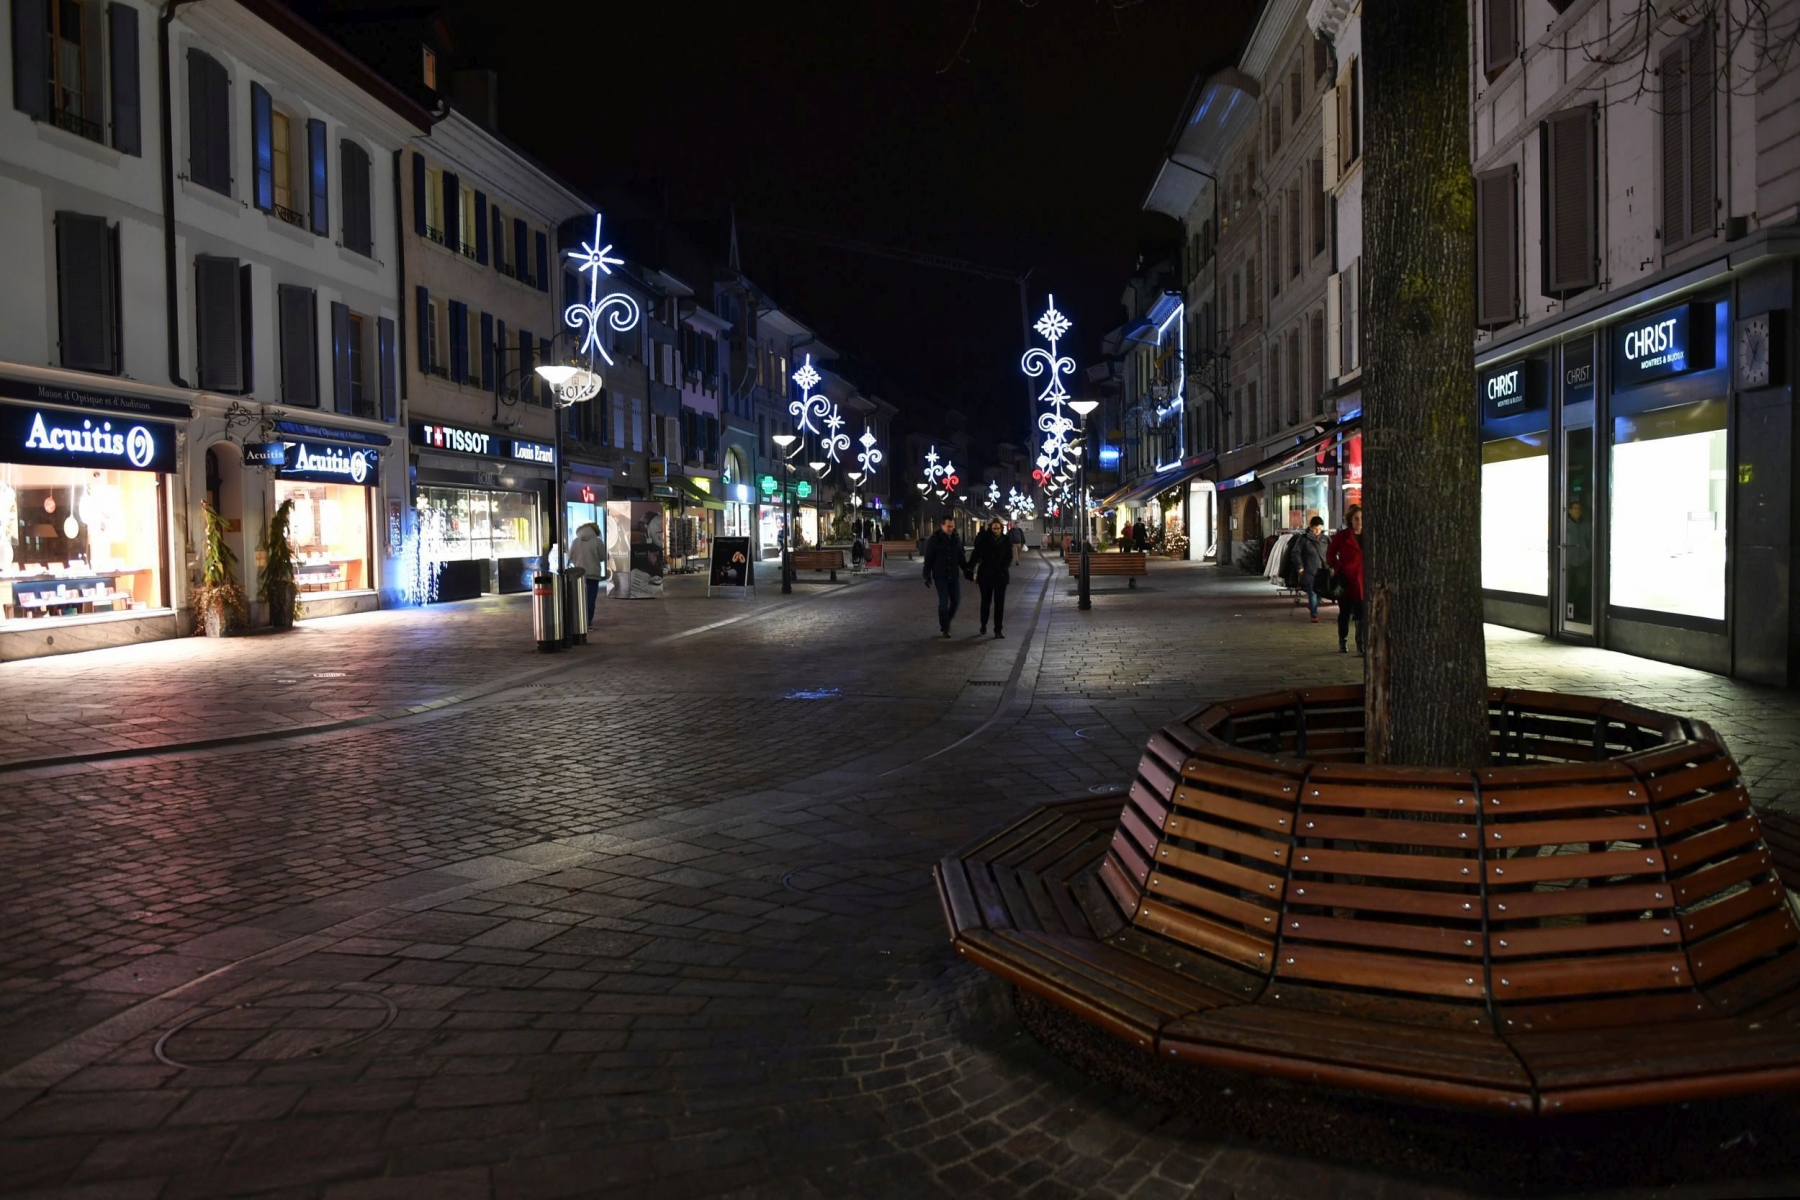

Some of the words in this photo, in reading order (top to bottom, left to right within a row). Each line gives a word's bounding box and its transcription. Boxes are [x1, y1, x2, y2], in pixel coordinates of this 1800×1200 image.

[1625, 318, 1677, 360] CHRIST
[1641, 355, 1662, 370] MONTRES
[1662, 355, 1667, 364] &
[1667, 350, 1685, 363] BIJOUX
[1487, 370, 1519, 400] CHRIST
[1567, 364, 1591, 385] CHRIST
[37, 386, 63, 399] Maison
[64, 390, 104, 407] d'Optique
[104, 396, 112, 405] et
[113, 395, 151, 410] d'Audition
[26, 411, 125, 455] Acuitis
[246, 450, 284, 460] Acuitis
[295, 443, 352, 474] Acuitis
[514, 441, 534, 461] Louis
[534, 444, 553, 463] Erard
